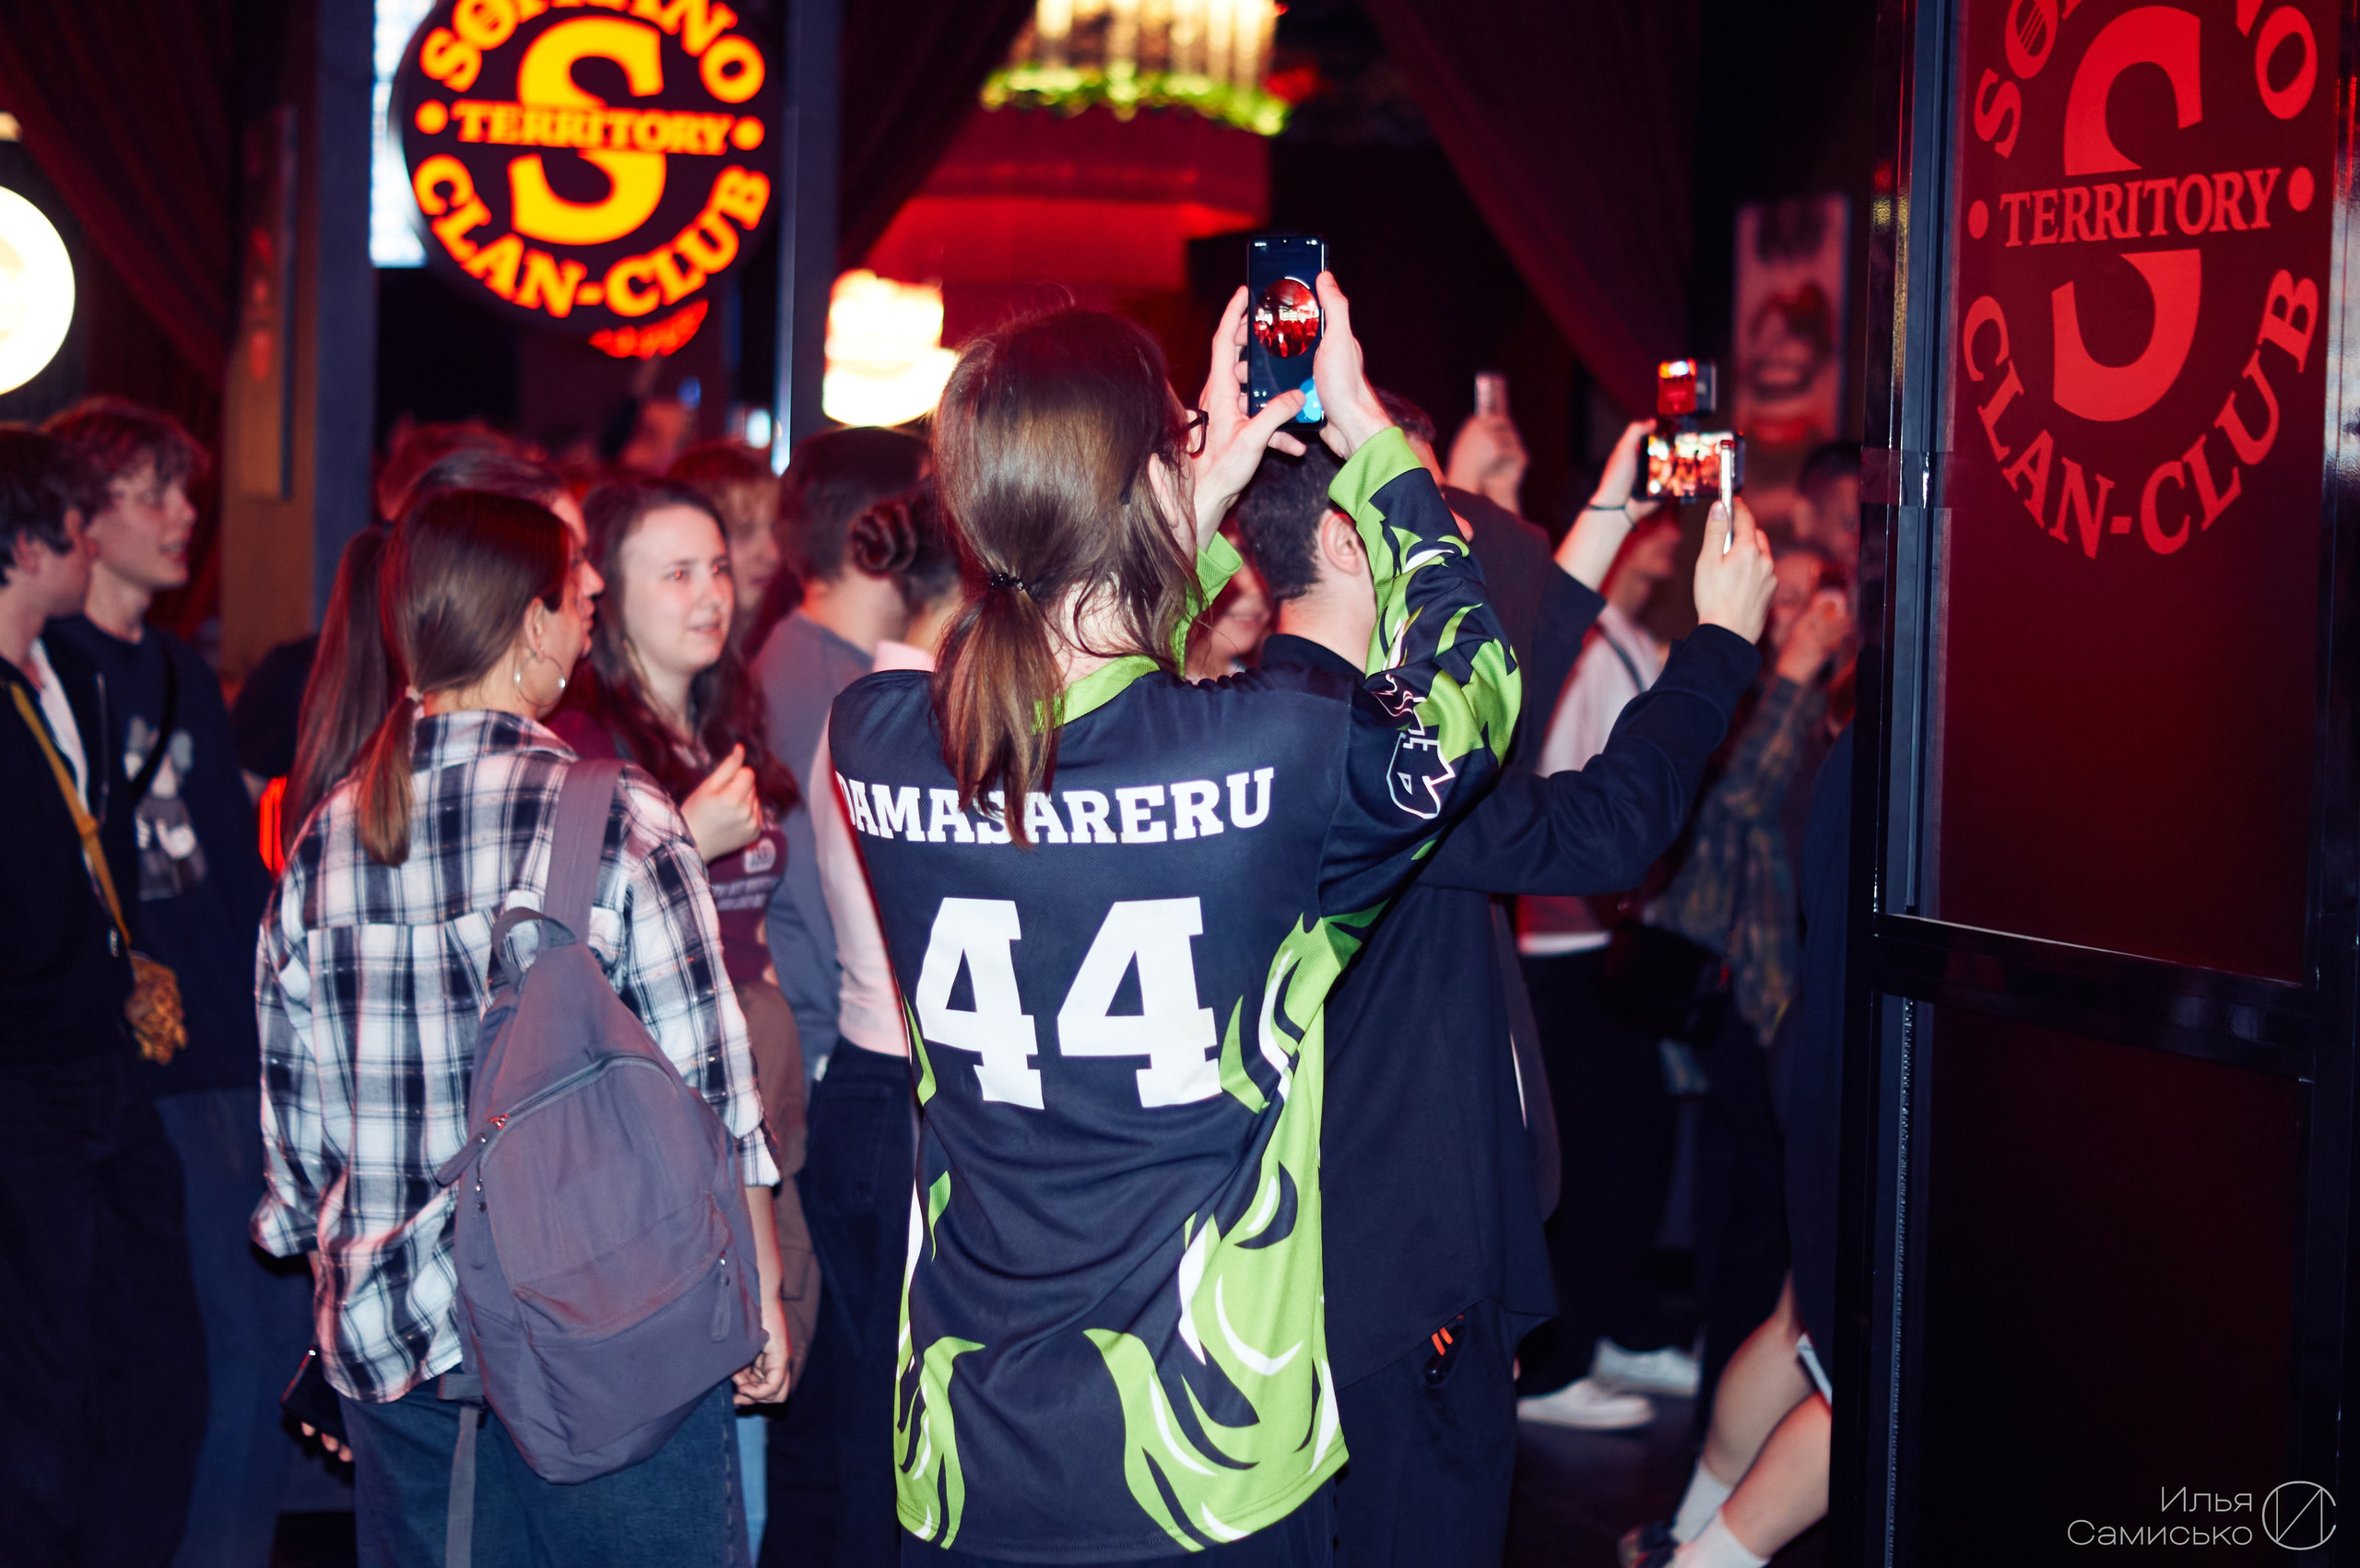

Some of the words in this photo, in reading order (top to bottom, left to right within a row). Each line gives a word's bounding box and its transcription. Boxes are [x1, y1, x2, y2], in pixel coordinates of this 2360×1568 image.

[420, 0, 765, 103] SONO
[451, 100, 735, 155] TERRITORY
[2000, 168, 2282, 247] TERRITORY
[916, 896, 1222, 1109] 44
